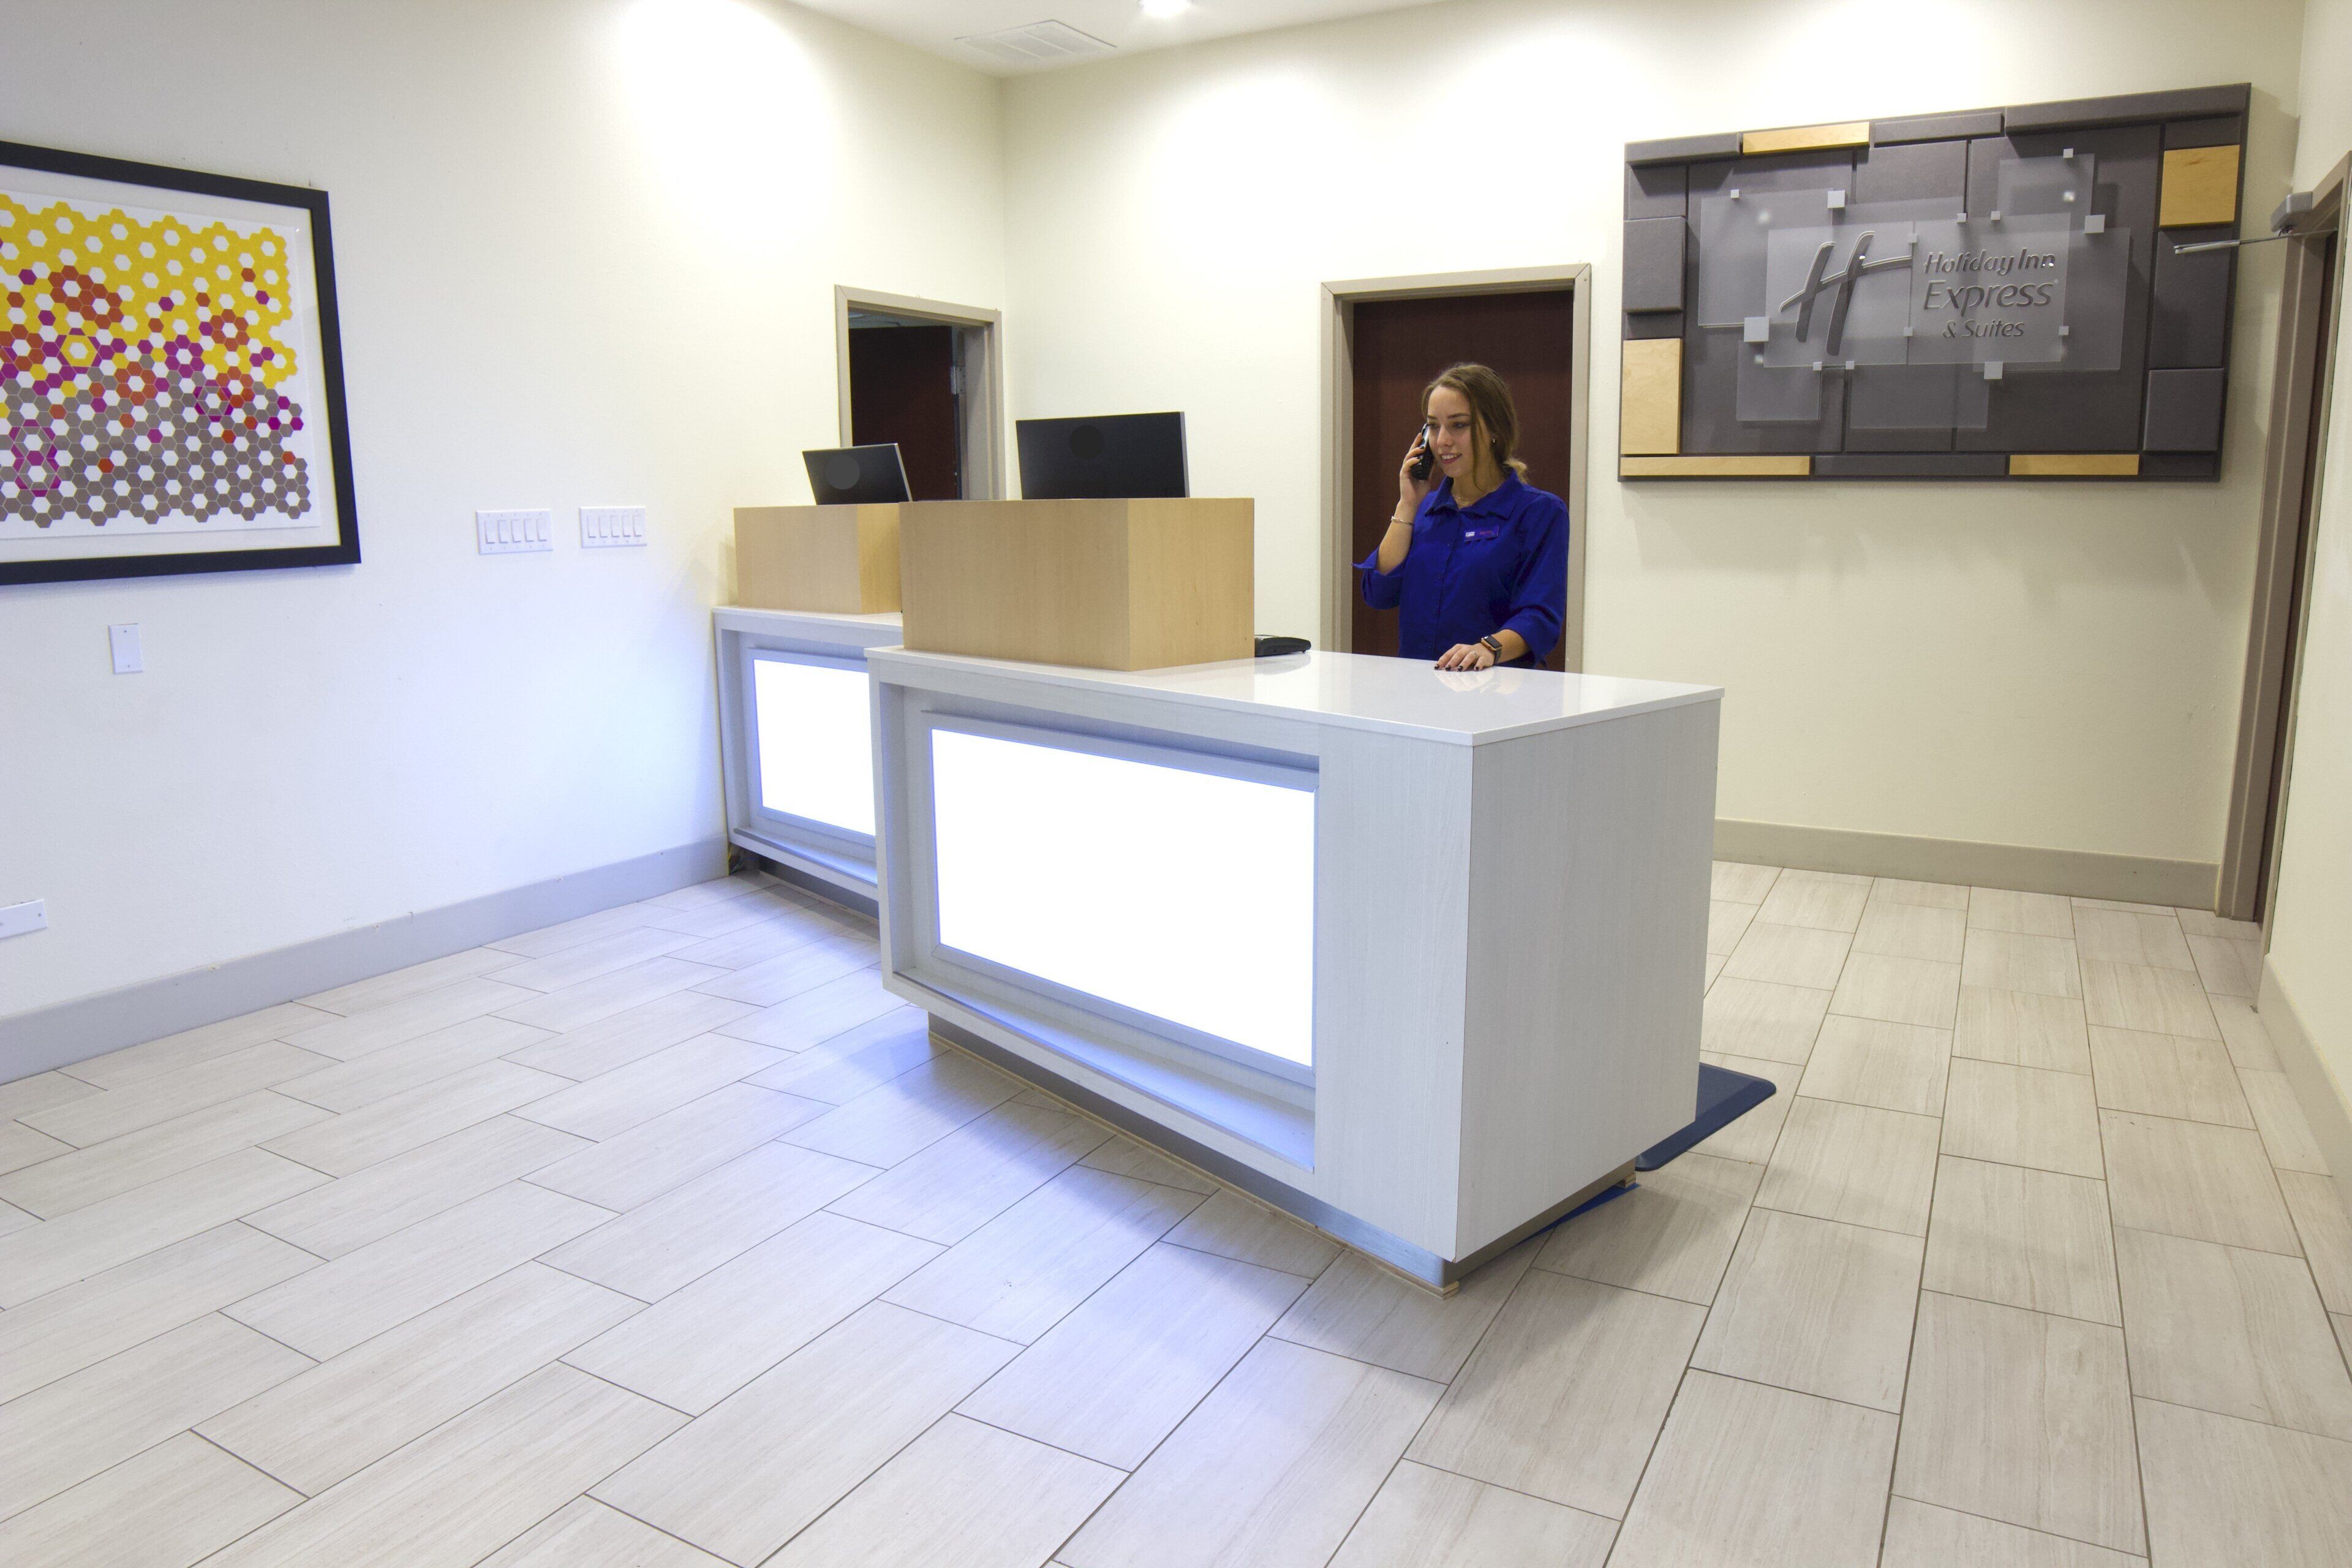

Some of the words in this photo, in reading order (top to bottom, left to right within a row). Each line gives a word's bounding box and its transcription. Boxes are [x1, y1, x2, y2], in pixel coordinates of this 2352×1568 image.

[1923, 249, 2015, 276] Holiday
[2018, 247, 2056, 270] Inn
[1924, 280, 2054, 317] Express
[1942, 320, 1956, 337] &
[1962, 319, 2025, 337] Suites
